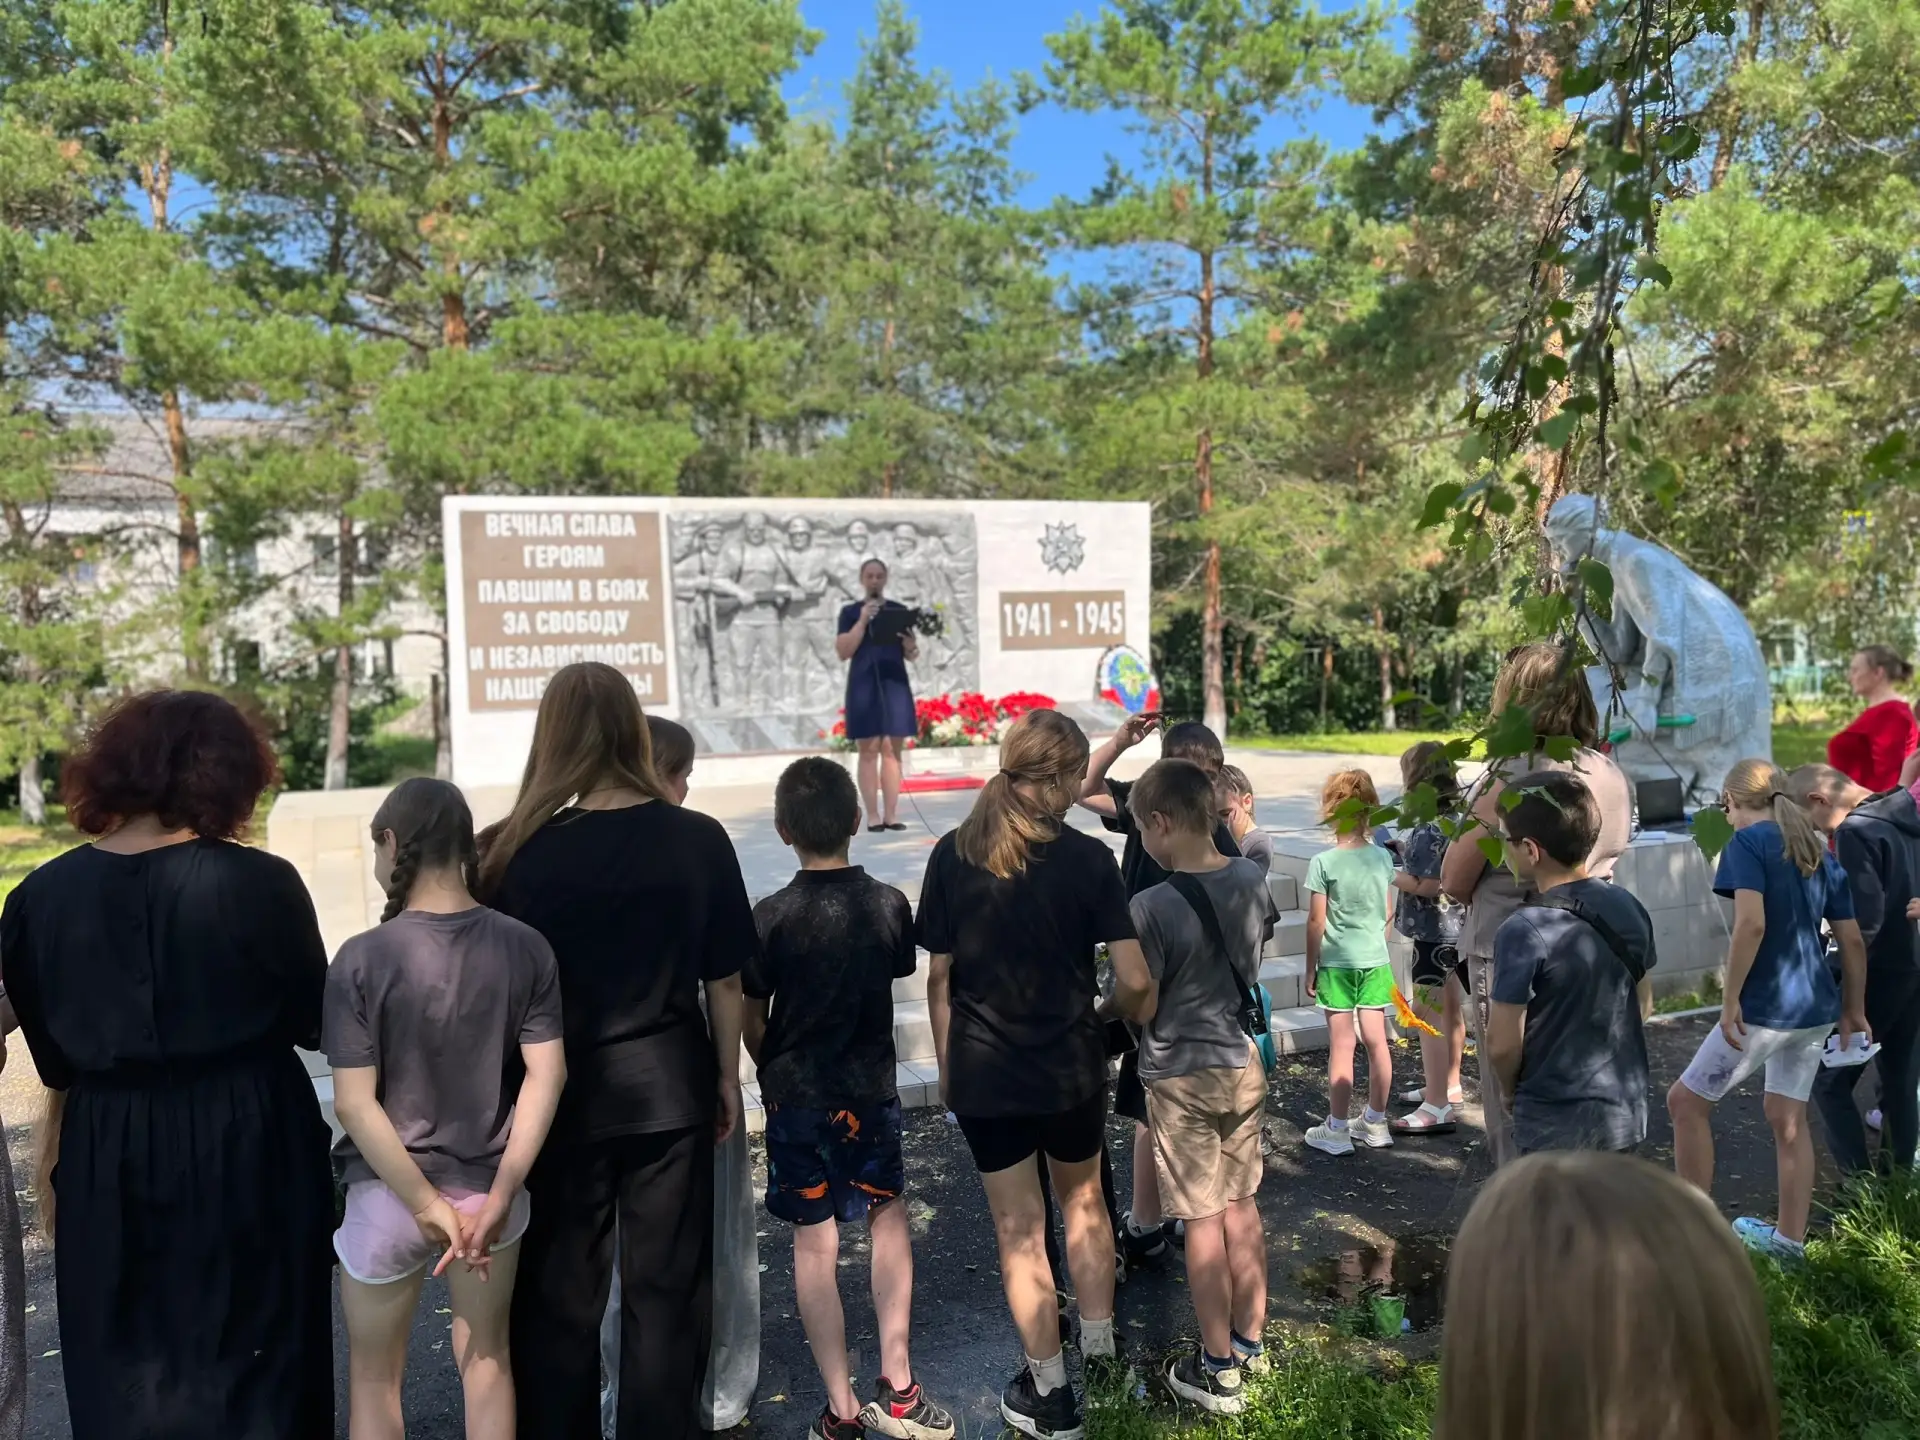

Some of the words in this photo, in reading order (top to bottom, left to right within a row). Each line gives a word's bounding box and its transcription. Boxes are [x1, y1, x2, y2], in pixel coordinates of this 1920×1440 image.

[485, 513, 565, 538] ВЕЧНАЯ
[569, 514, 636, 537] СЛАВА
[522, 545, 605, 568] ГЕРОЯМ
[478, 580, 574, 604] ПАВШИМ
[578, 579, 593, 602] В
[597, 578, 650, 601] БОЯХ
[502, 611, 531, 636] ЗА
[535, 610, 630, 636] СВОБОДУ
[1003, 602, 1051, 637] 1941
[1074, 601, 1123, 635] 1945
[469, 646, 484, 670] И
[489, 643, 664, 670] НЕЗАВИСИМОСТЬ
[485, 673, 552, 702] НАШЕ
